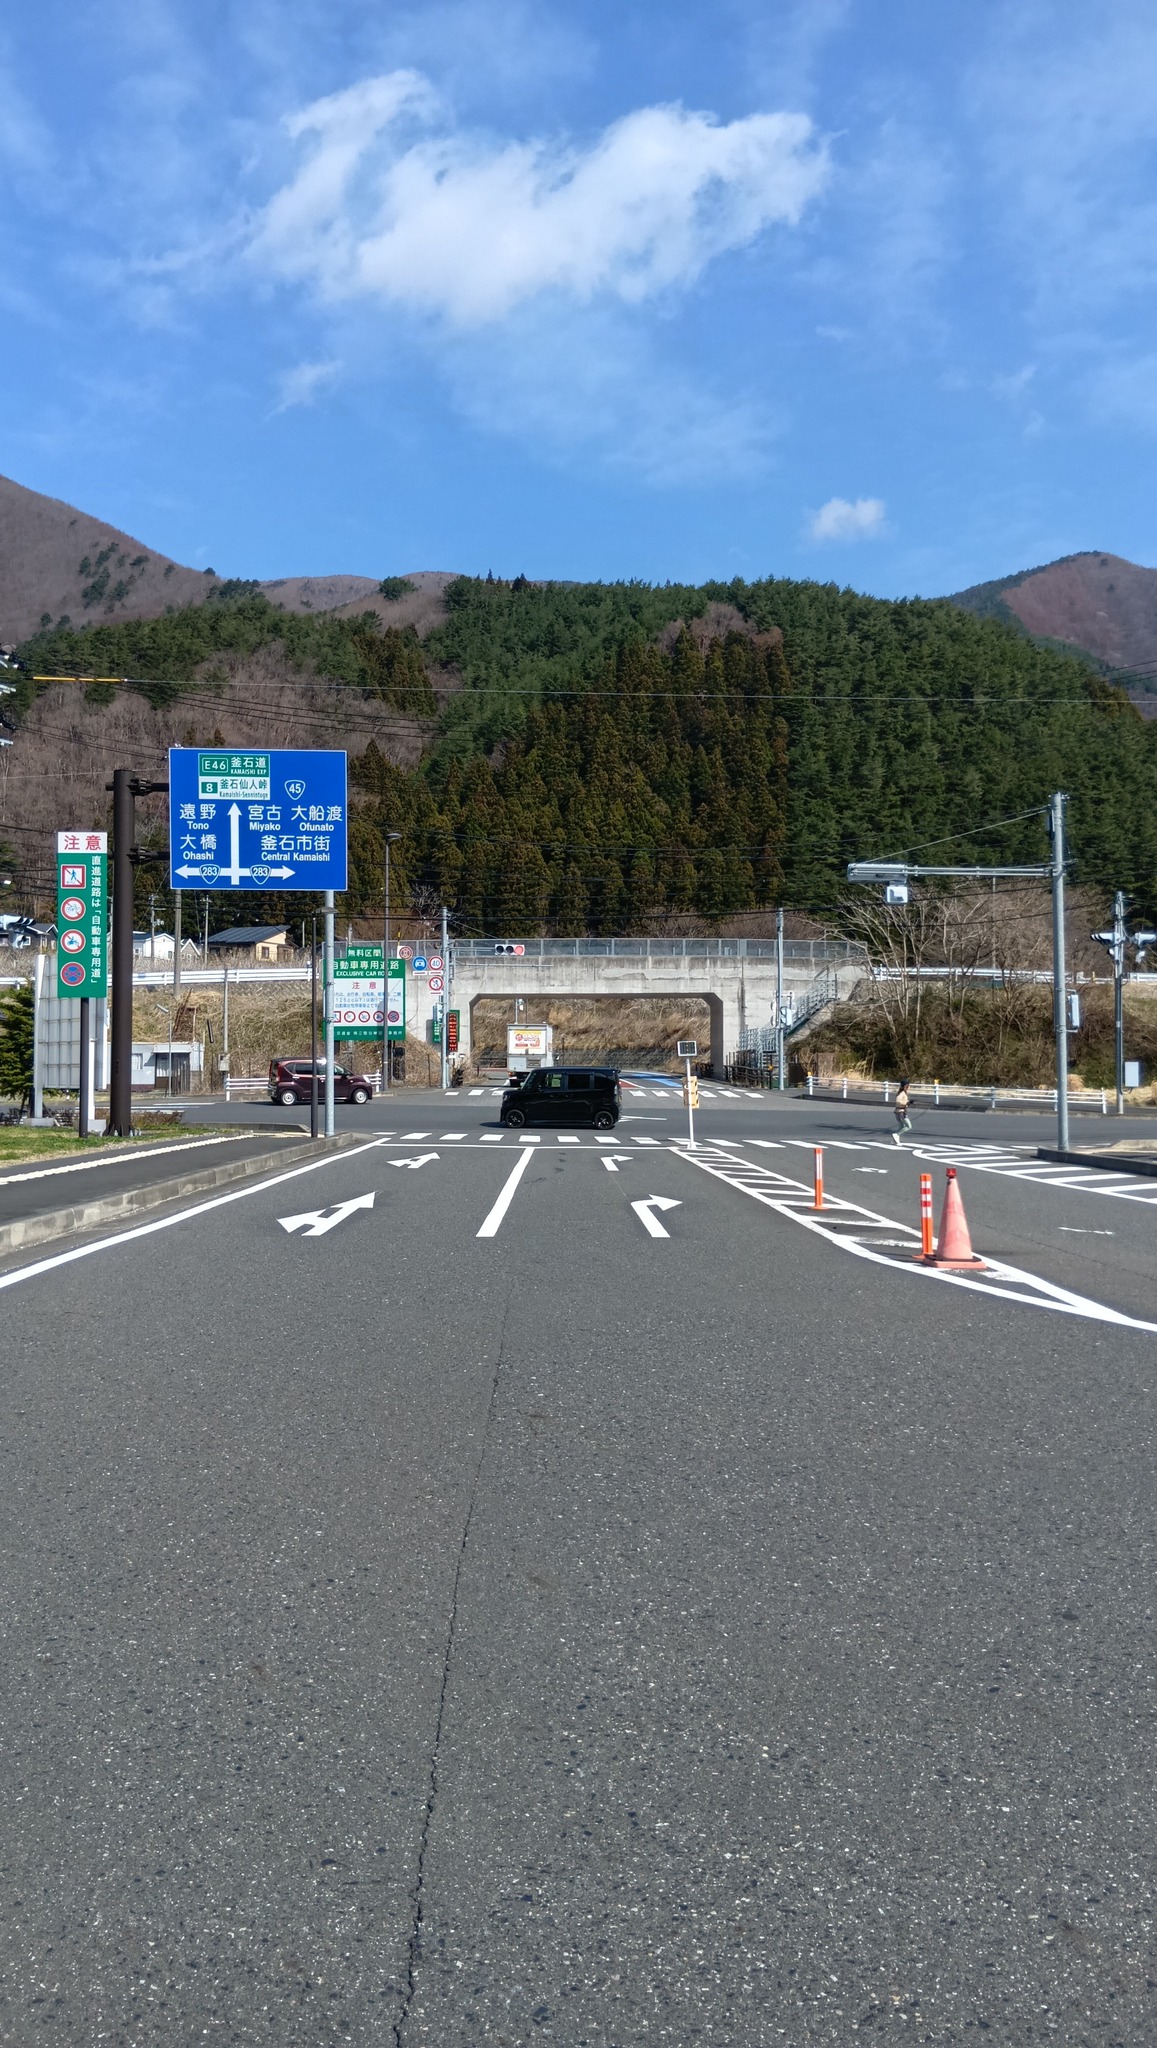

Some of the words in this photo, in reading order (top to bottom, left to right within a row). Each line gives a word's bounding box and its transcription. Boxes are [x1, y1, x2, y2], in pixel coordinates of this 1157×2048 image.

[204, 761, 226, 770] E46
[230, 756, 267, 769] 釜石道
[206, 783, 213, 792] 8
[220, 778, 268, 790] 釜石仙人峠
[289, 783, 301, 794] 45
[179, 803, 217, 820] 遠野
[247, 804, 282, 821] 宮古
[290, 805, 343, 822] 大船渡
[186, 821, 210, 830] Tono
[249, 822, 281, 832] Miyako
[299, 822, 335, 832] Ofunato
[64, 834, 102, 851] 注意
[179, 834, 217, 850] 大橋
[260, 835, 331, 852] 釜石市街
[182, 851, 214, 861] Ohashi
[261, 852, 290, 861] Central
[293, 852, 330, 862] Kamaishi
[202, 866, 218, 876] 283
[253, 867, 268, 877] 283
[347, 949, 382, 957] 無料区間
